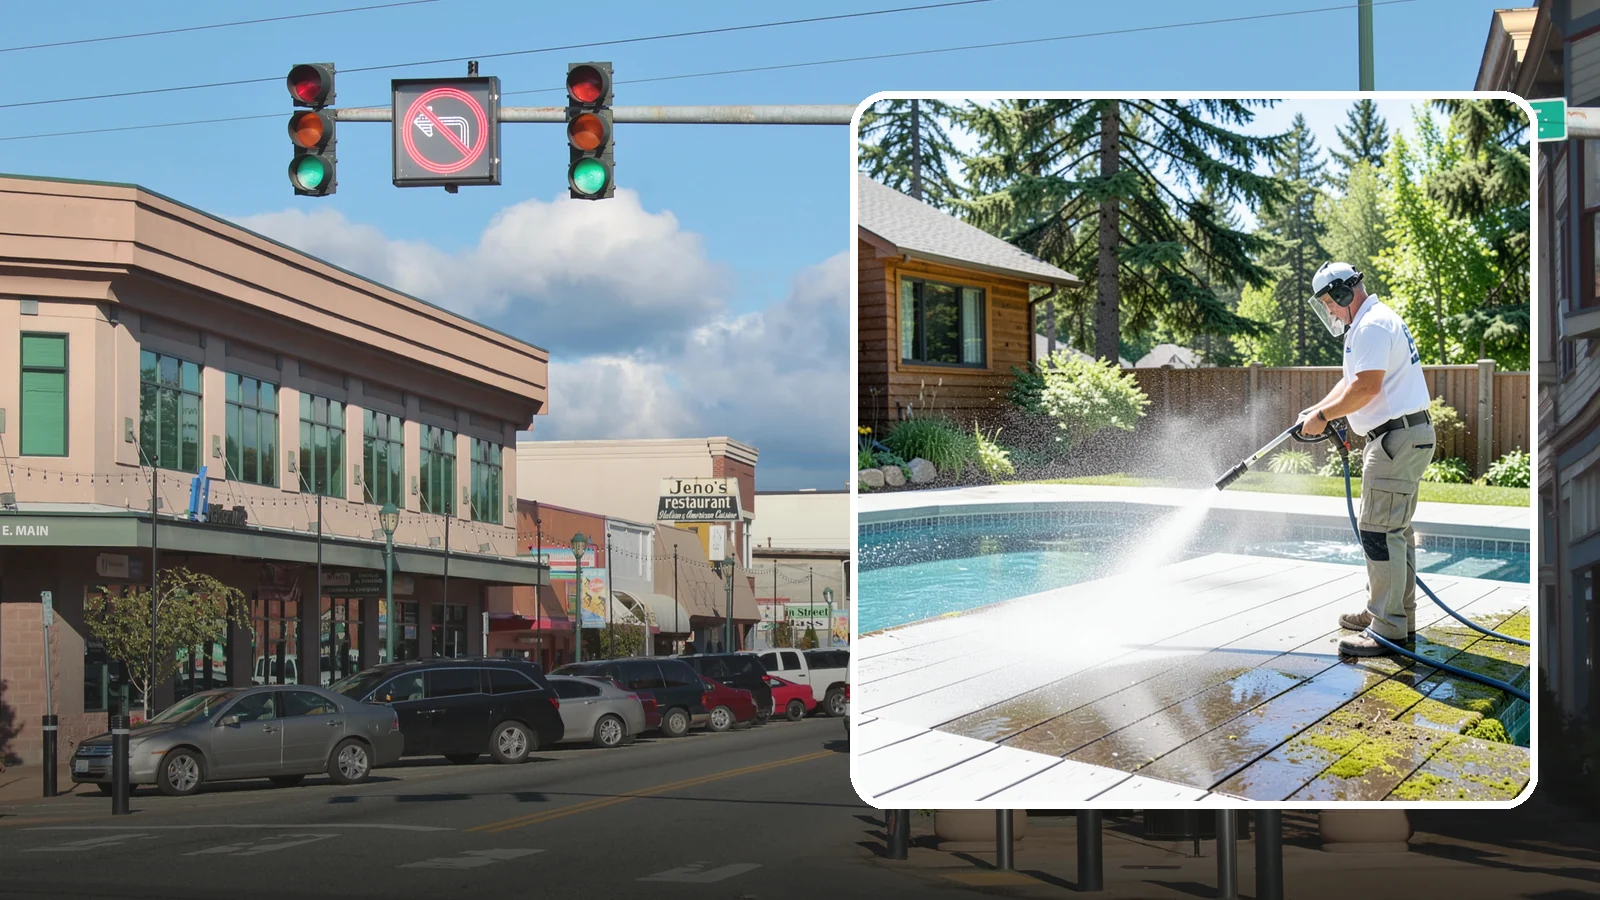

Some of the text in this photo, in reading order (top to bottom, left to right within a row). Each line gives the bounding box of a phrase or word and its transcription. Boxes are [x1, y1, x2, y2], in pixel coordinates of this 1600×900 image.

[670, 480, 728, 494] Jeno's
[665, 496, 731, 509] restaurant
[658, 510, 682, 520] Italian
[686, 509, 714, 519] American
[714, 509, 738, 519] Cuisine
[2, 525, 49, 537] E. MAIN
[785, 607, 795, 617] in
[797, 607, 829, 616] Street
[787, 619, 824, 627] lass
